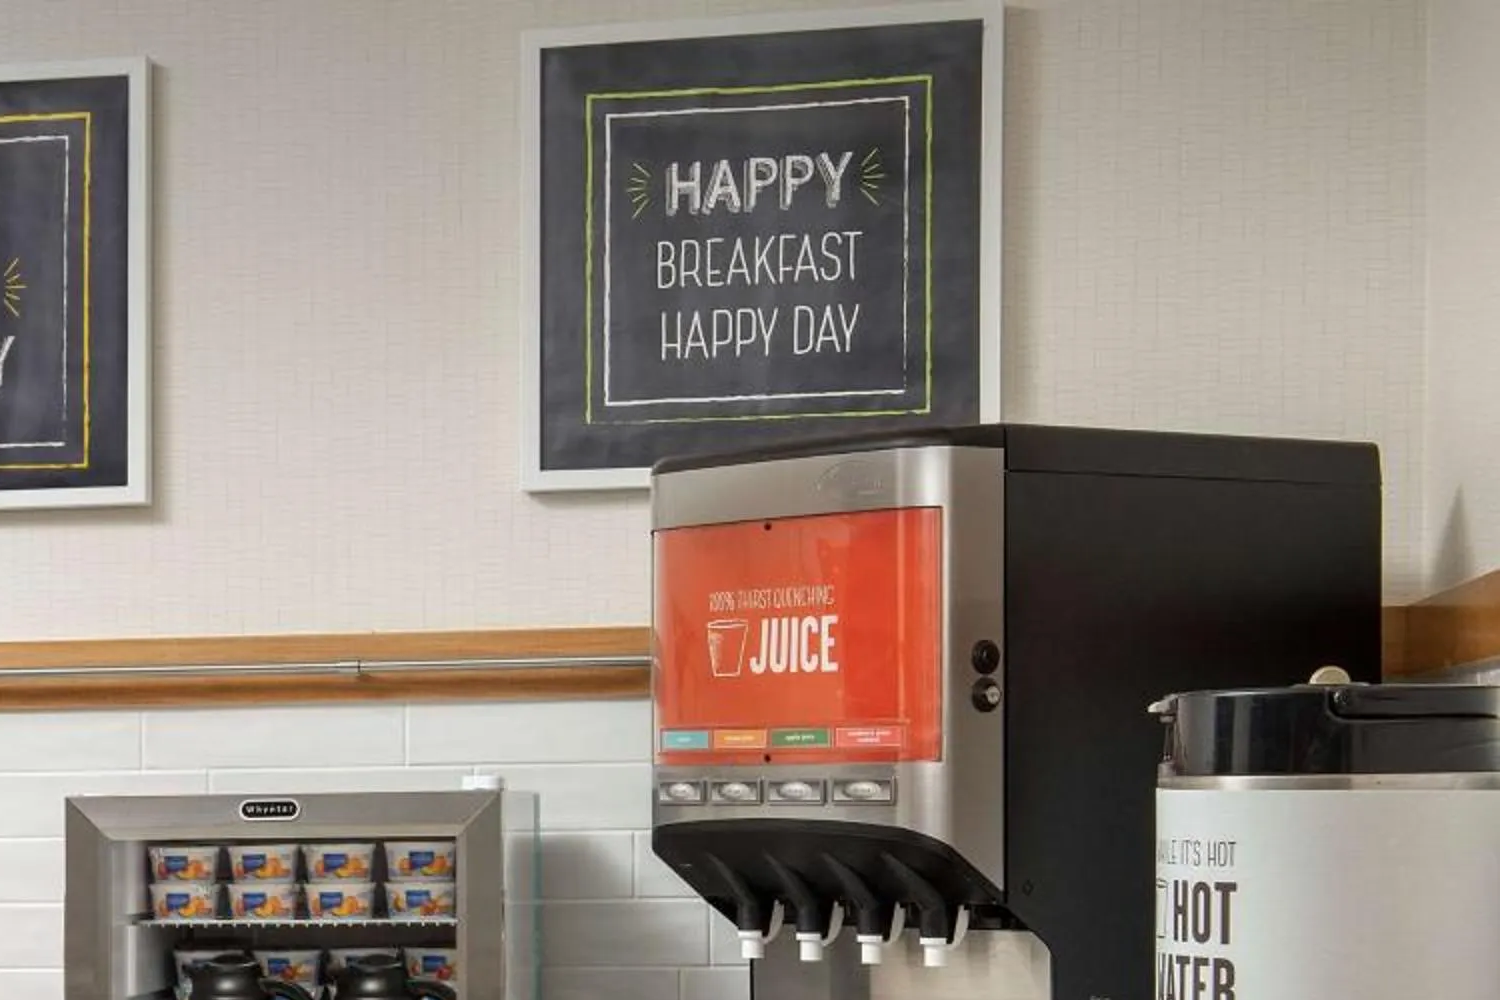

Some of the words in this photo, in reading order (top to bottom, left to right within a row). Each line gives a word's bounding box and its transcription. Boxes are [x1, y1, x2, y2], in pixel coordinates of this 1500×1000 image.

[665, 150, 853, 216] HAPPY
[657, 231, 863, 289] BREAKFAST
[660, 308, 778, 361] HAPPY
[793, 303, 860, 355] DAY
[750, 615, 839, 674] JUICE
[1207, 841, 1237, 868] HOT
[1173, 879, 1237, 945] HOT
